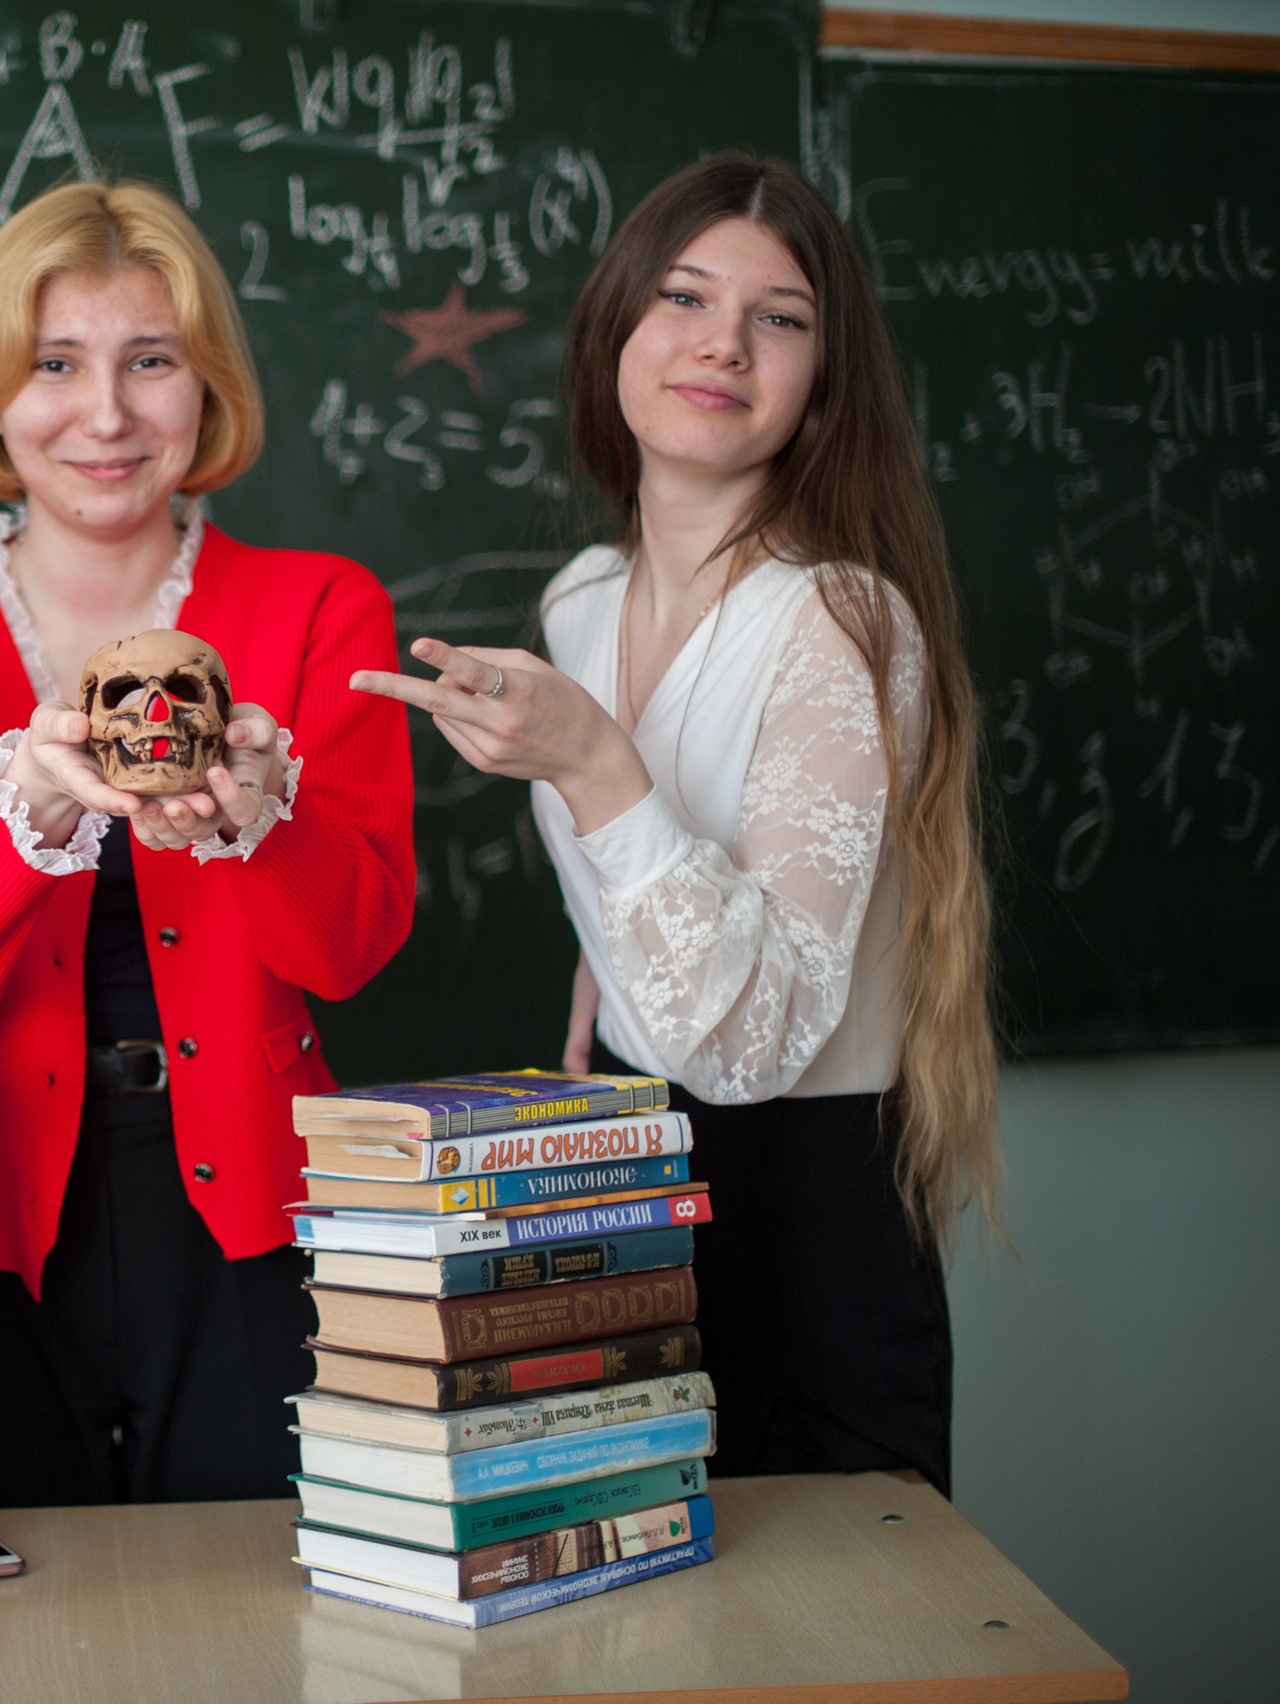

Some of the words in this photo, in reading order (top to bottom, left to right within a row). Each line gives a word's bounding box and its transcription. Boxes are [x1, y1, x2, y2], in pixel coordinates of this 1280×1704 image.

[514, 1096, 589, 1122] ЭКОНОМИКА
[540, 1127, 639, 1164] ПОЗНАЮ
[645, 1124, 663, 1155] Я
[480, 1137, 535, 1171] МИР
[460, 1230, 479, 1243] XIX
[482, 1228, 502, 1241] век
[516, 1210, 588, 1240] ИСТОРИЯ
[593, 1203, 653, 1230] РОССИИ
[675, 1199, 696, 1218] 8
[489, 1296, 569, 1317] ПУТЕШЕСТВЕННИКА
[495, 1313, 533, 1327] РУССКОГО
[501, 1554, 529, 1569] ЗНАНИЙ
[637, 1560, 649, 1572] ПО
[650, 1545, 695, 1569] ПРАКТИКУМ
[471, 1563, 529, 1584] ЭКОНОМИЧЕСКИХ
[500, 1571, 529, 1584] ОСНОВЫ
[600, 1564, 636, 1584] ОСНОВАМ
[532, 1574, 600, 1602] ЭКОНОМИЧЕСКОЙ
[499, 1595, 531, 1613] ТЕОРИИ
